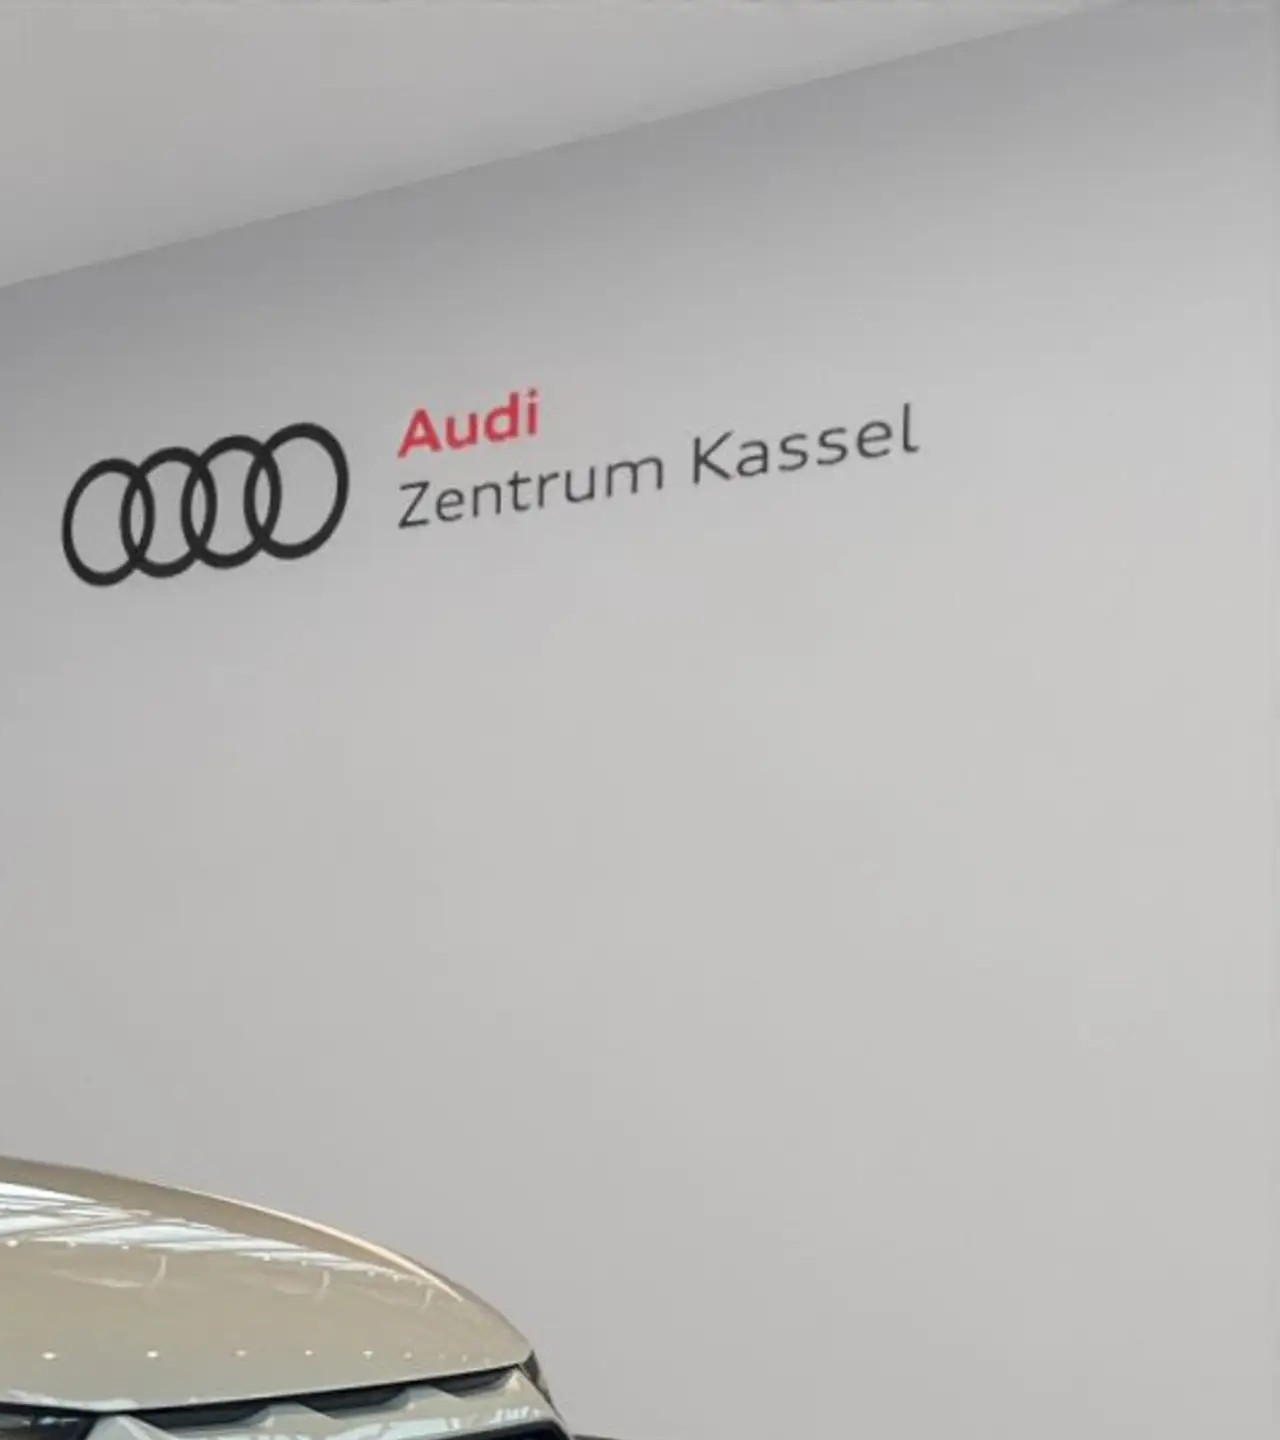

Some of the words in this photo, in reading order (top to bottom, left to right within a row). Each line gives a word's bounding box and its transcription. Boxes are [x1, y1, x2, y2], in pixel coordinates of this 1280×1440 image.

[396, 457, 665, 530] Zentrum
[692, 402, 920, 485] Kassel
[397, 389, 540, 458] Audi
